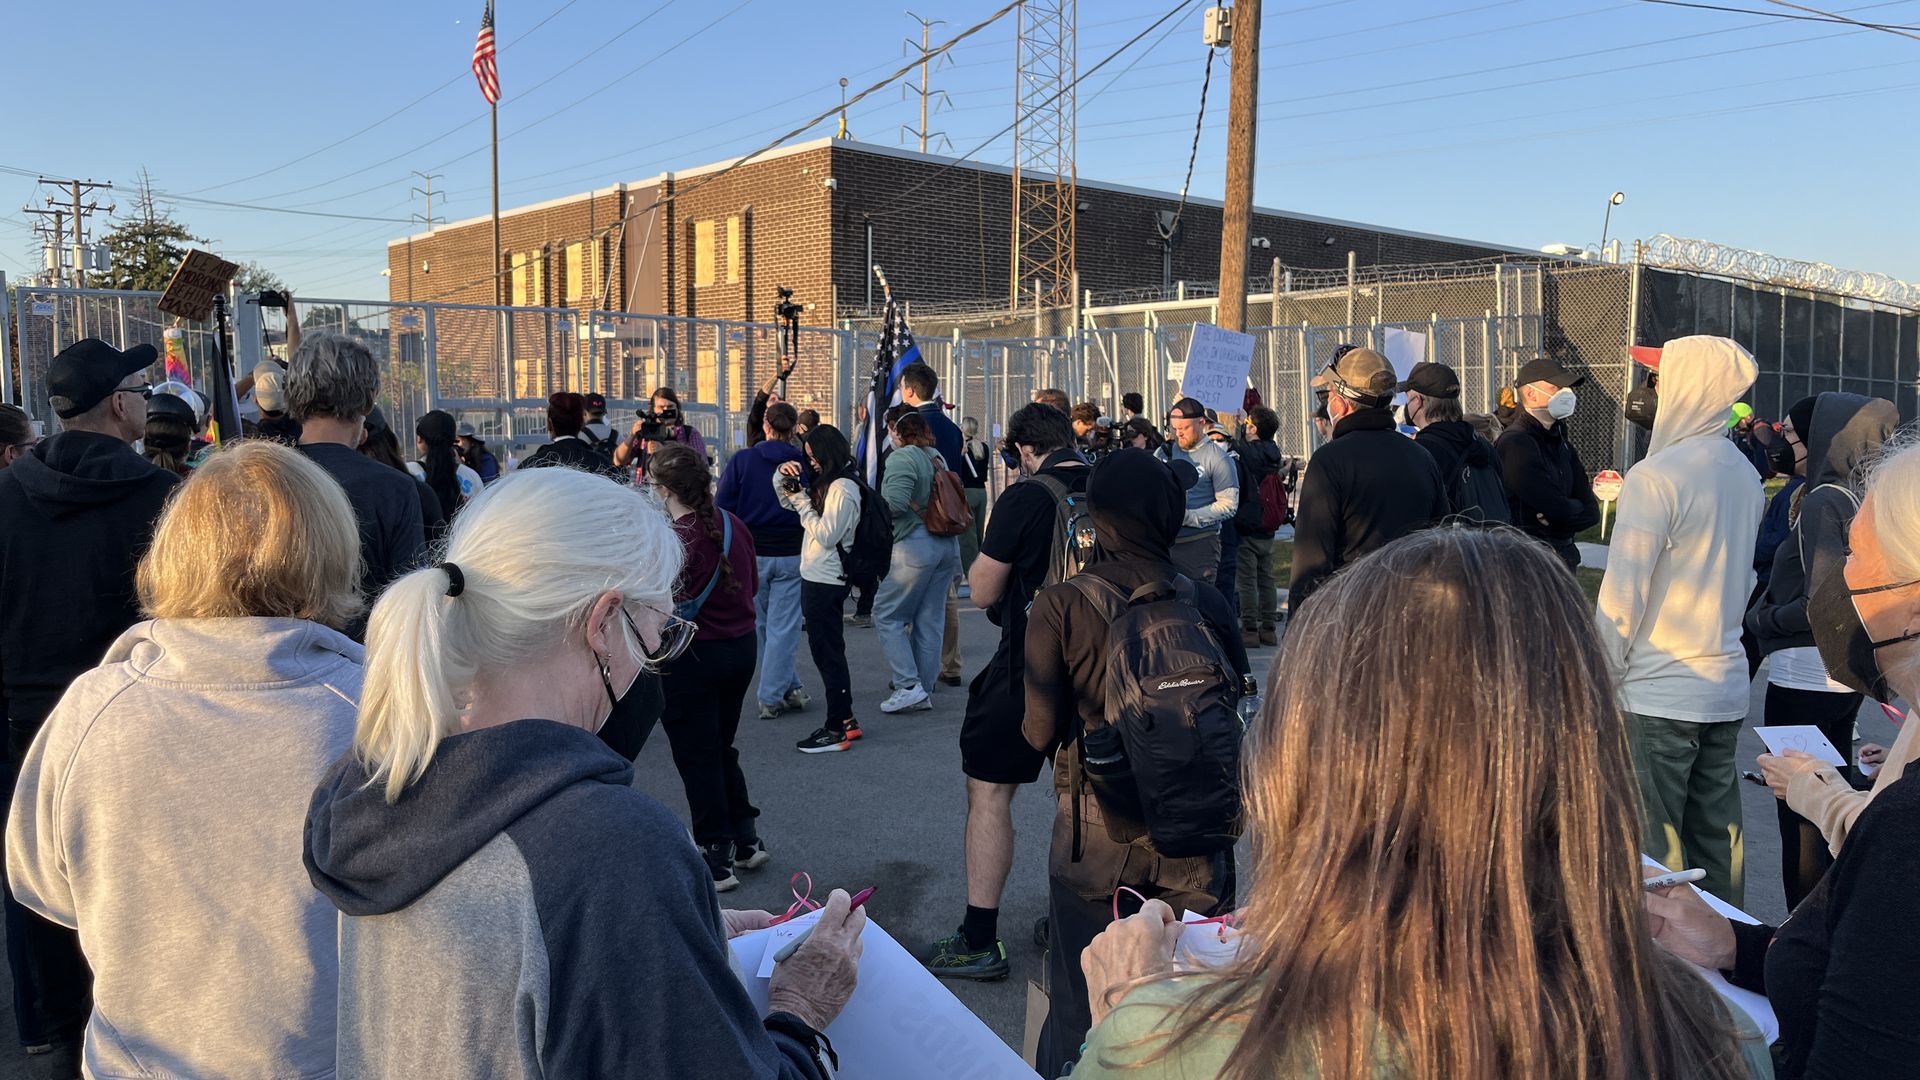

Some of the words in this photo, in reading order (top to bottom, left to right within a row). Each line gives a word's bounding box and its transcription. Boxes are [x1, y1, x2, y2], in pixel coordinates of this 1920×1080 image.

[182, 269, 227, 294] MORONS
[165, 297, 211, 322] MASKS
[1226, 375, 1237, 389] TO
